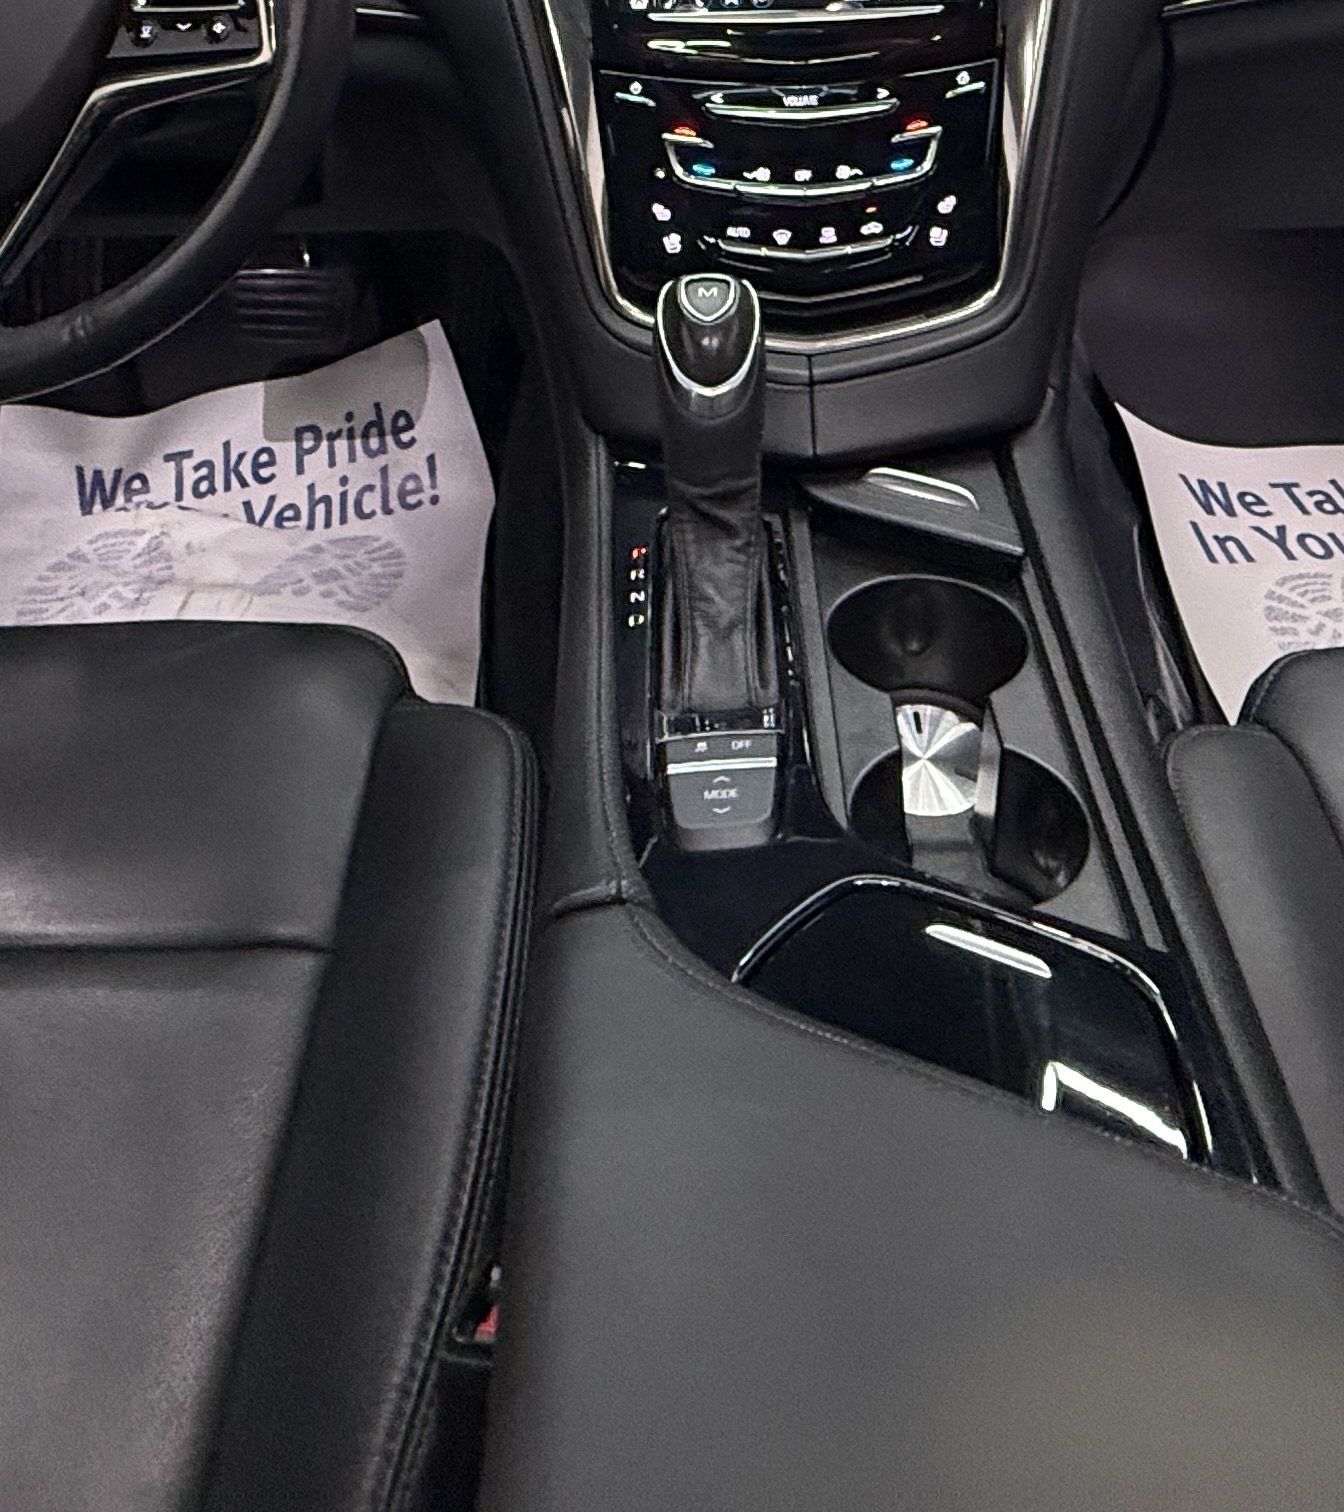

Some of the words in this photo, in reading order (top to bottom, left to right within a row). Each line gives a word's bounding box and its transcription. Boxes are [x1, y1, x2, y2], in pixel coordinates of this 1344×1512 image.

[75, 463, 150, 517] We
[163, 439, 277, 504] Take
[294, 401, 416, 475] Pride
[242, 452, 441, 531] Vehicle!
[1179, 471, 1270, 519] We
[1188, 520, 1255, 565] In
[630, 590, 646, 603] N
[731, 739, 752, 750] OFF
[703, 788, 738, 800] MODE
